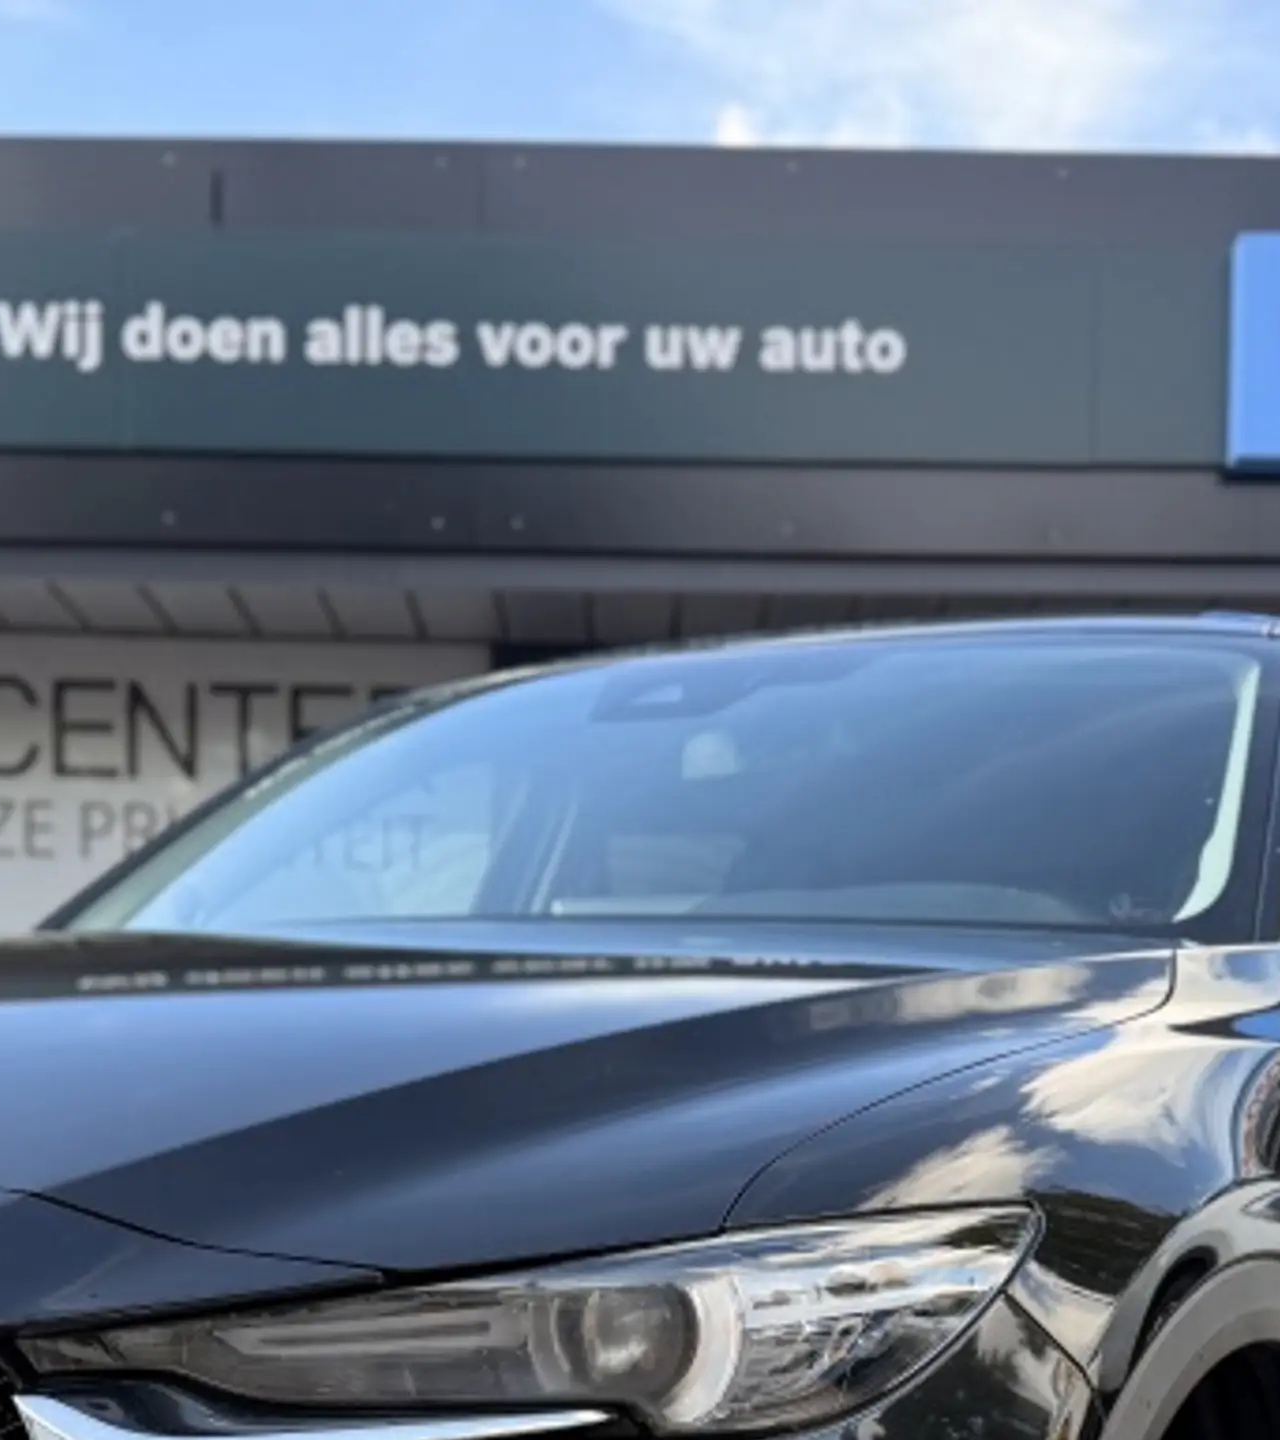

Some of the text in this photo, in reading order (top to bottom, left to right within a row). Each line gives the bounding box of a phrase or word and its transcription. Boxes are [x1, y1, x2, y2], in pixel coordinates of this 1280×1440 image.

[122, 301, 286, 362] doen
[304, 305, 460, 366] alles
[477, 323, 628, 368] voor
[644, 326, 742, 370] uw
[759, 320, 907, 373] auto
